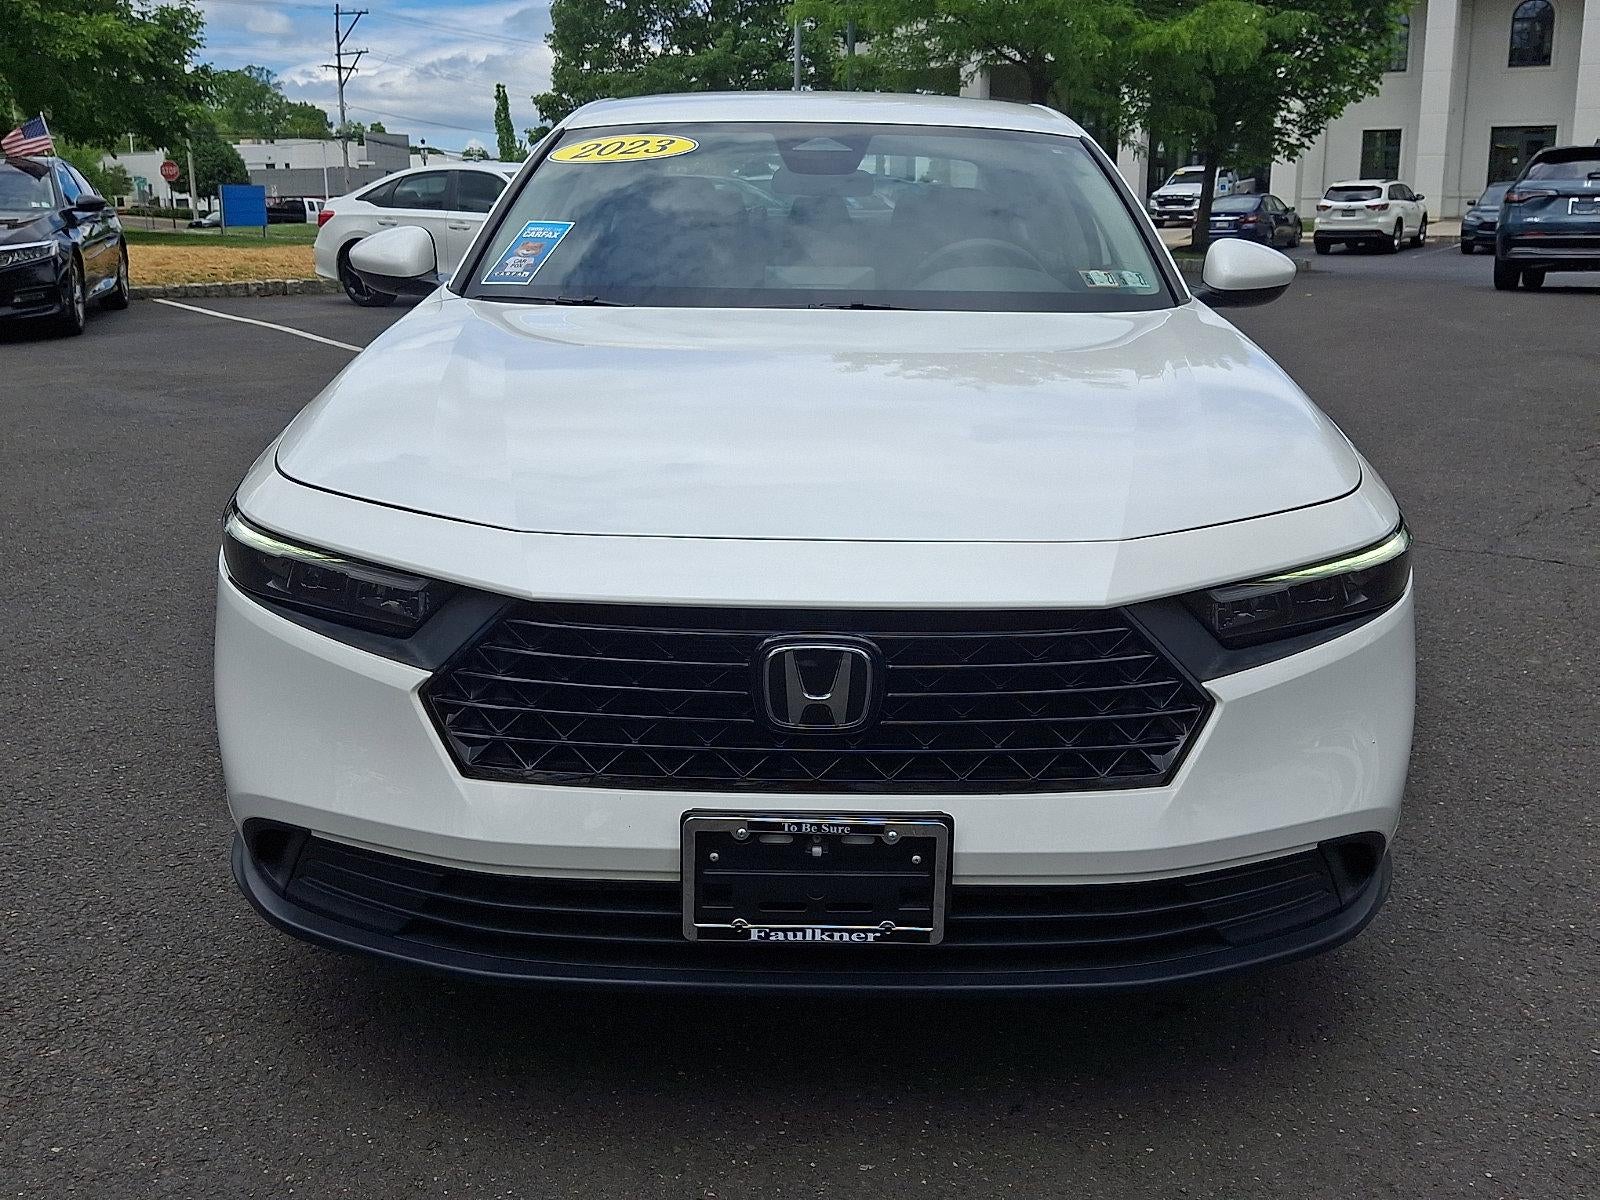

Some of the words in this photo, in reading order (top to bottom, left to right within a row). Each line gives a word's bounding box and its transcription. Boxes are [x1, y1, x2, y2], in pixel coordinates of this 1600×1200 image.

[570, 139, 676, 160] 2023
[522, 230, 561, 239] CARFAX
[781, 822, 798, 832] To
[801, 823, 818, 833] Be
[821, 823, 851, 834] Sure
[748, 928, 881, 942] Faulkner
